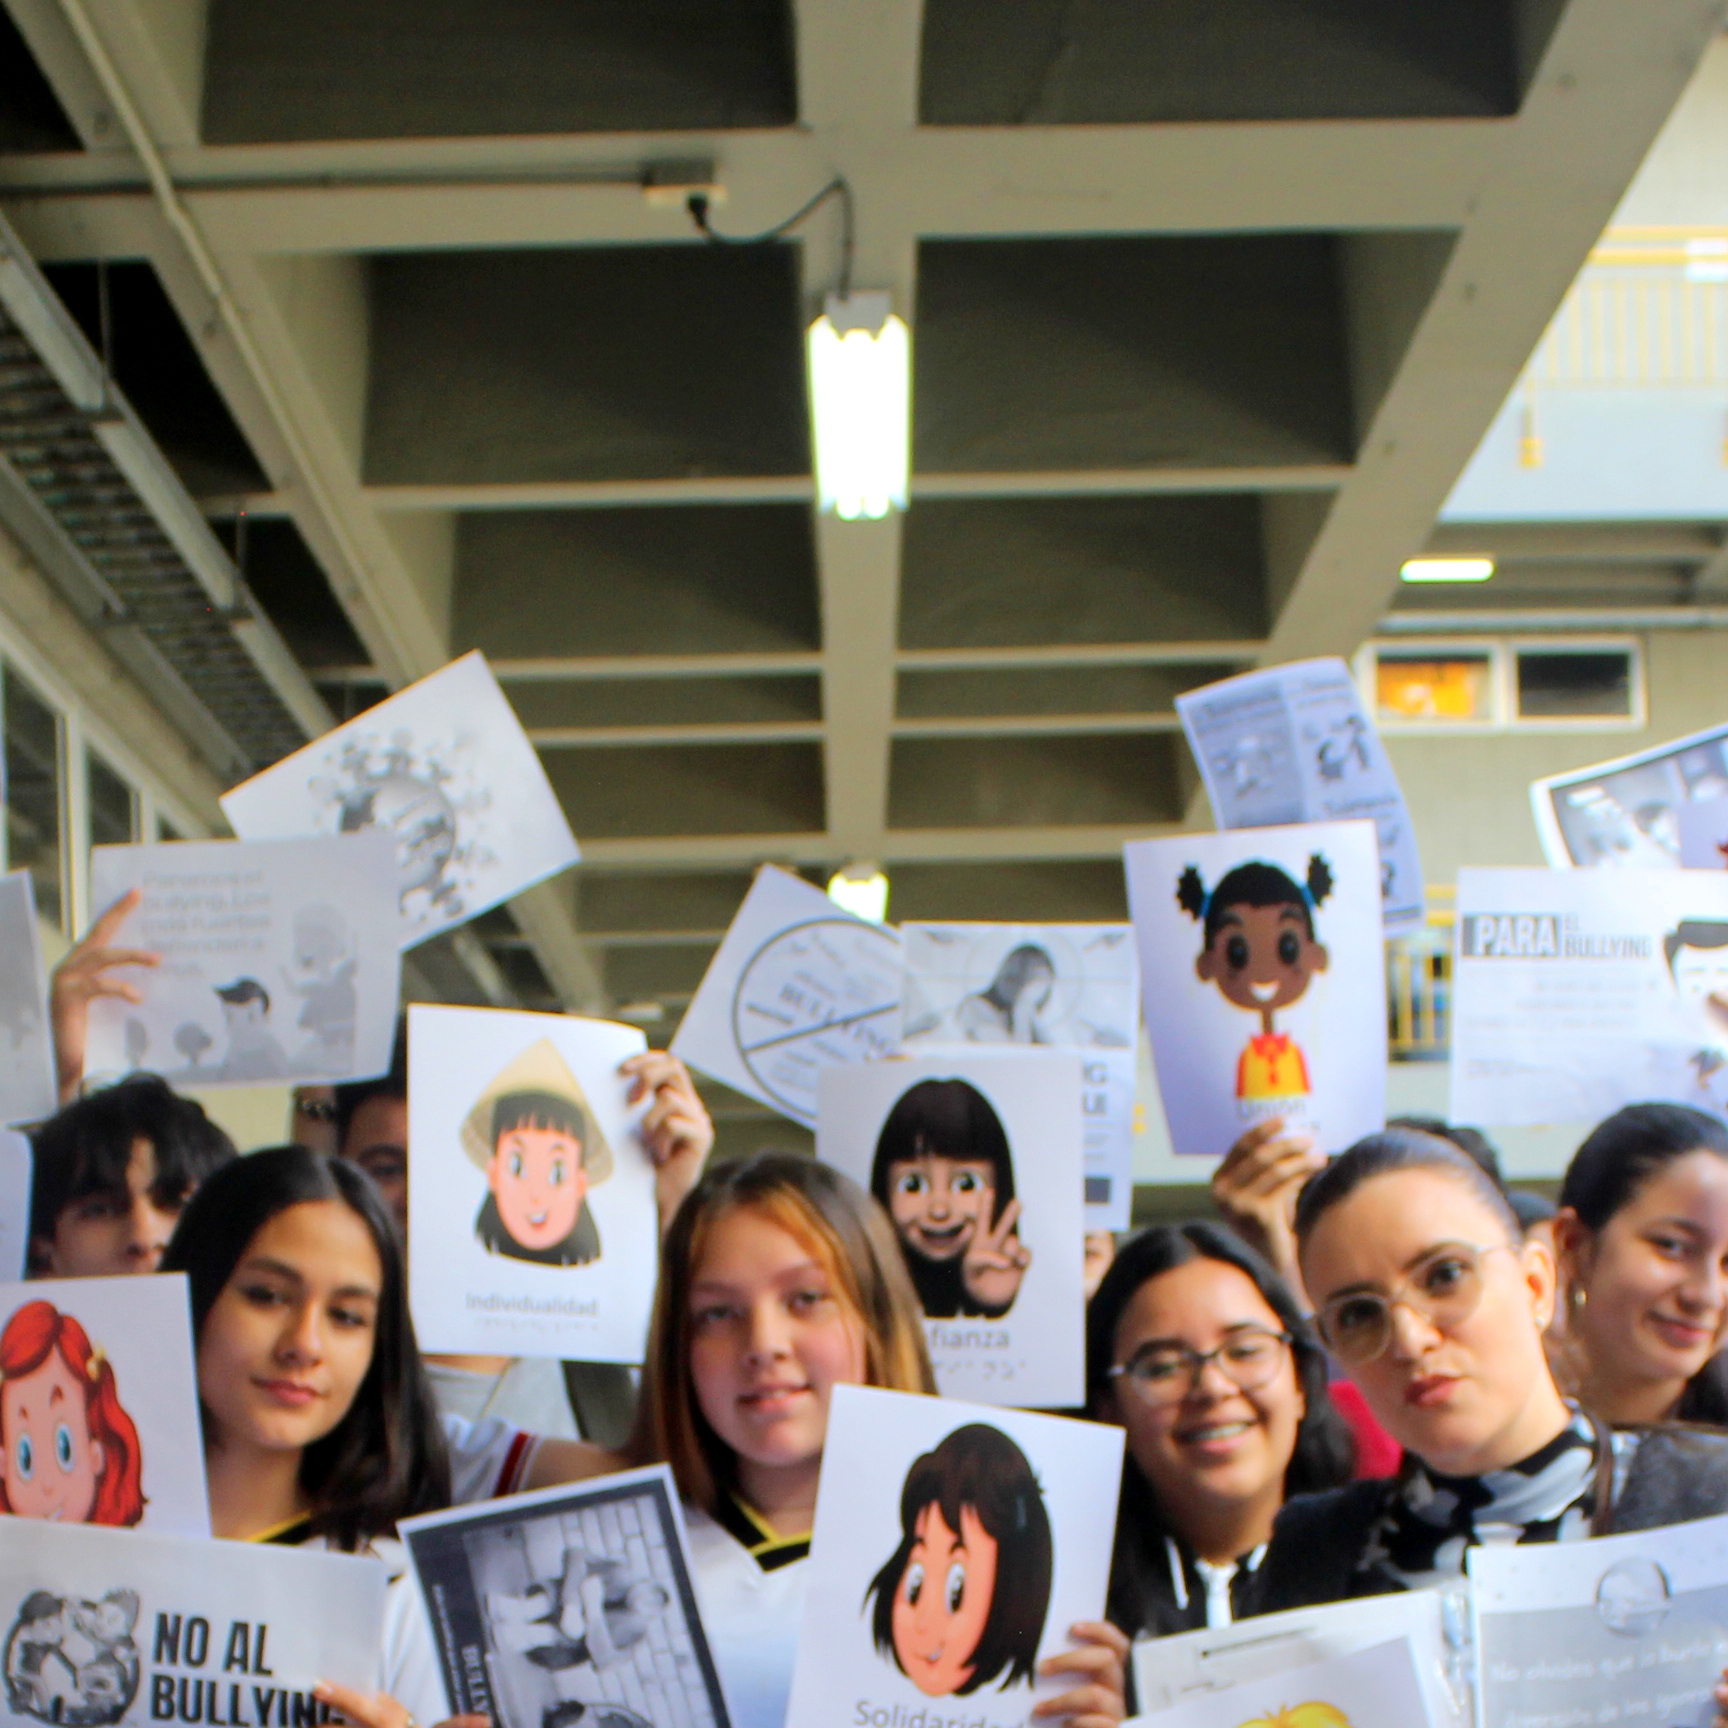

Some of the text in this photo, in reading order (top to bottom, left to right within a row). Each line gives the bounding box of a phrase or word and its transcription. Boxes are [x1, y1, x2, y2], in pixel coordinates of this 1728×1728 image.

[1474, 914, 1558, 955] PARA
[1563, 932, 1653, 959] BULLYING
[465, 1291, 600, 1317] Individualidad
[153, 1611, 274, 1677] NO AL
